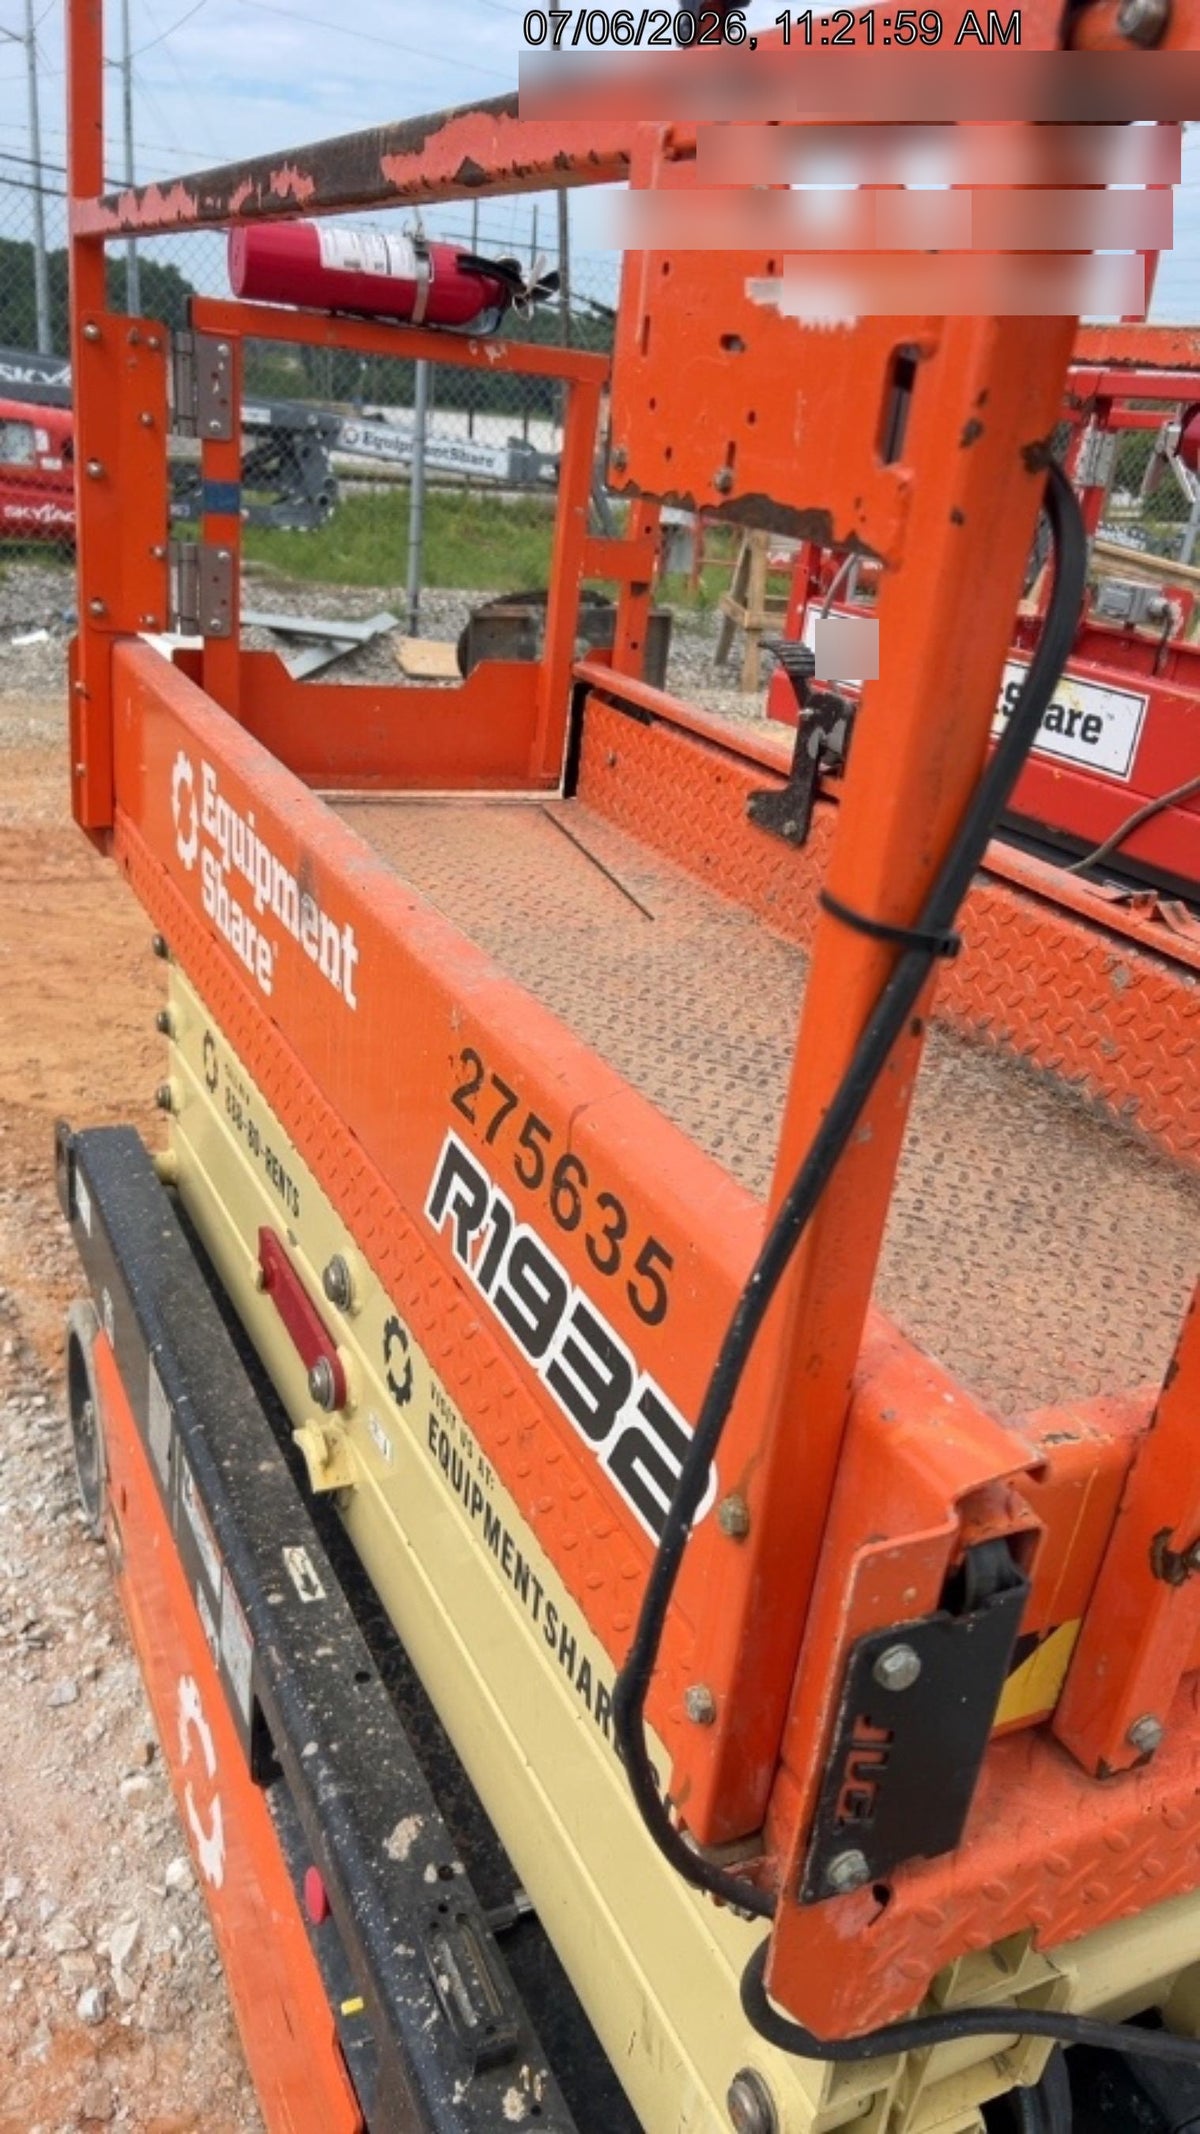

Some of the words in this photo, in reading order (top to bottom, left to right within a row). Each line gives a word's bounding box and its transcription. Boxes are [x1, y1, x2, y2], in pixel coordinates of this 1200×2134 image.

[201, 758, 359, 1010] Equipment
[202, 846, 275, 996] Share
[450, 1047, 674, 1327] 275635
[427, 1132, 716, 1546] R1932
[428, 1411, 632, 1768] EQUIPMENTSHAR
